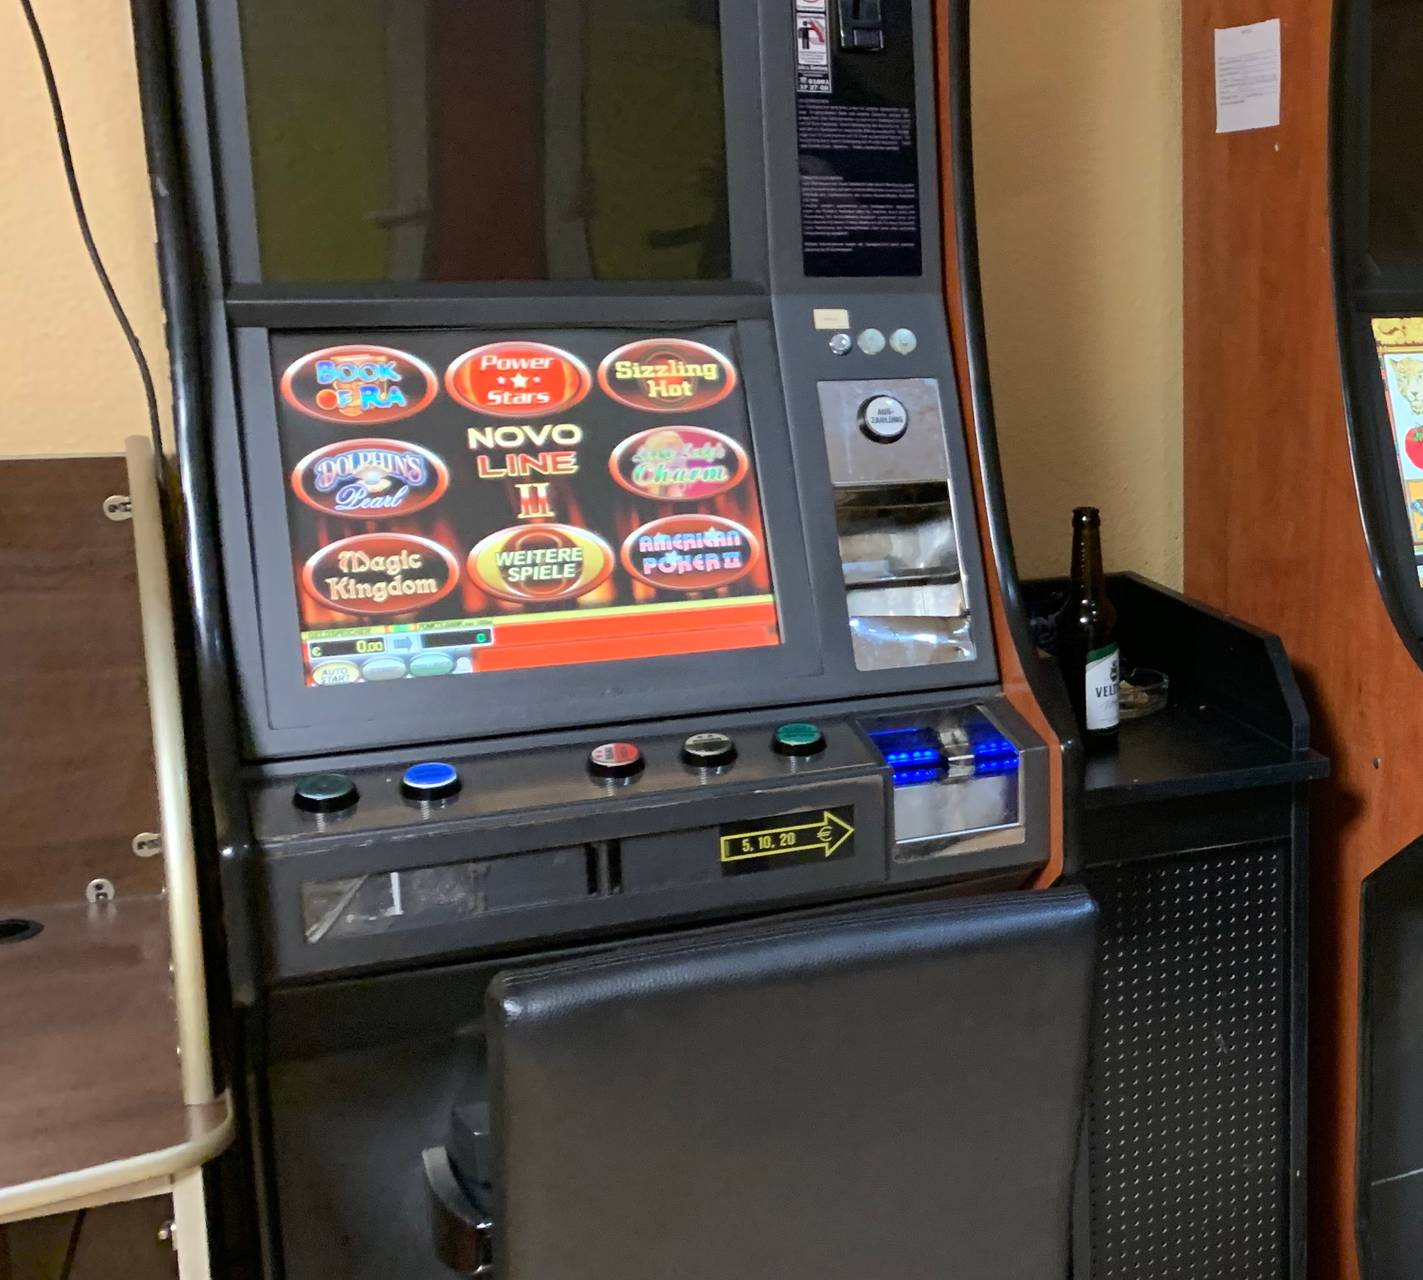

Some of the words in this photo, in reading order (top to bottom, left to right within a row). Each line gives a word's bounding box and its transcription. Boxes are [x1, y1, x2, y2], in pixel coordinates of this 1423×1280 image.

[316, 360, 402, 384] BOOK
[480, 354, 554, 371] Power
[615, 360, 718, 380] Sizzling
[359, 384, 408, 410] RA
[487, 389, 550, 406] Stars
[647, 379, 693, 398] Hot
[467, 423, 582, 449] NOVO
[477, 451, 579, 478] LINE
[632, 463, 730, 487] Charm
[335, 483, 409, 510] Pearl
[514, 482, 555, 519] II
[639, 528, 742, 552] AMERICAN
[338, 549, 422, 575] Magic
[495, 547, 583, 567] WEITERE
[643, 552, 721, 575] POKER
[508, 563, 577, 582] SPIELE
[325, 575, 438, 603] Kingdom
[779, 832, 796, 846] 20
